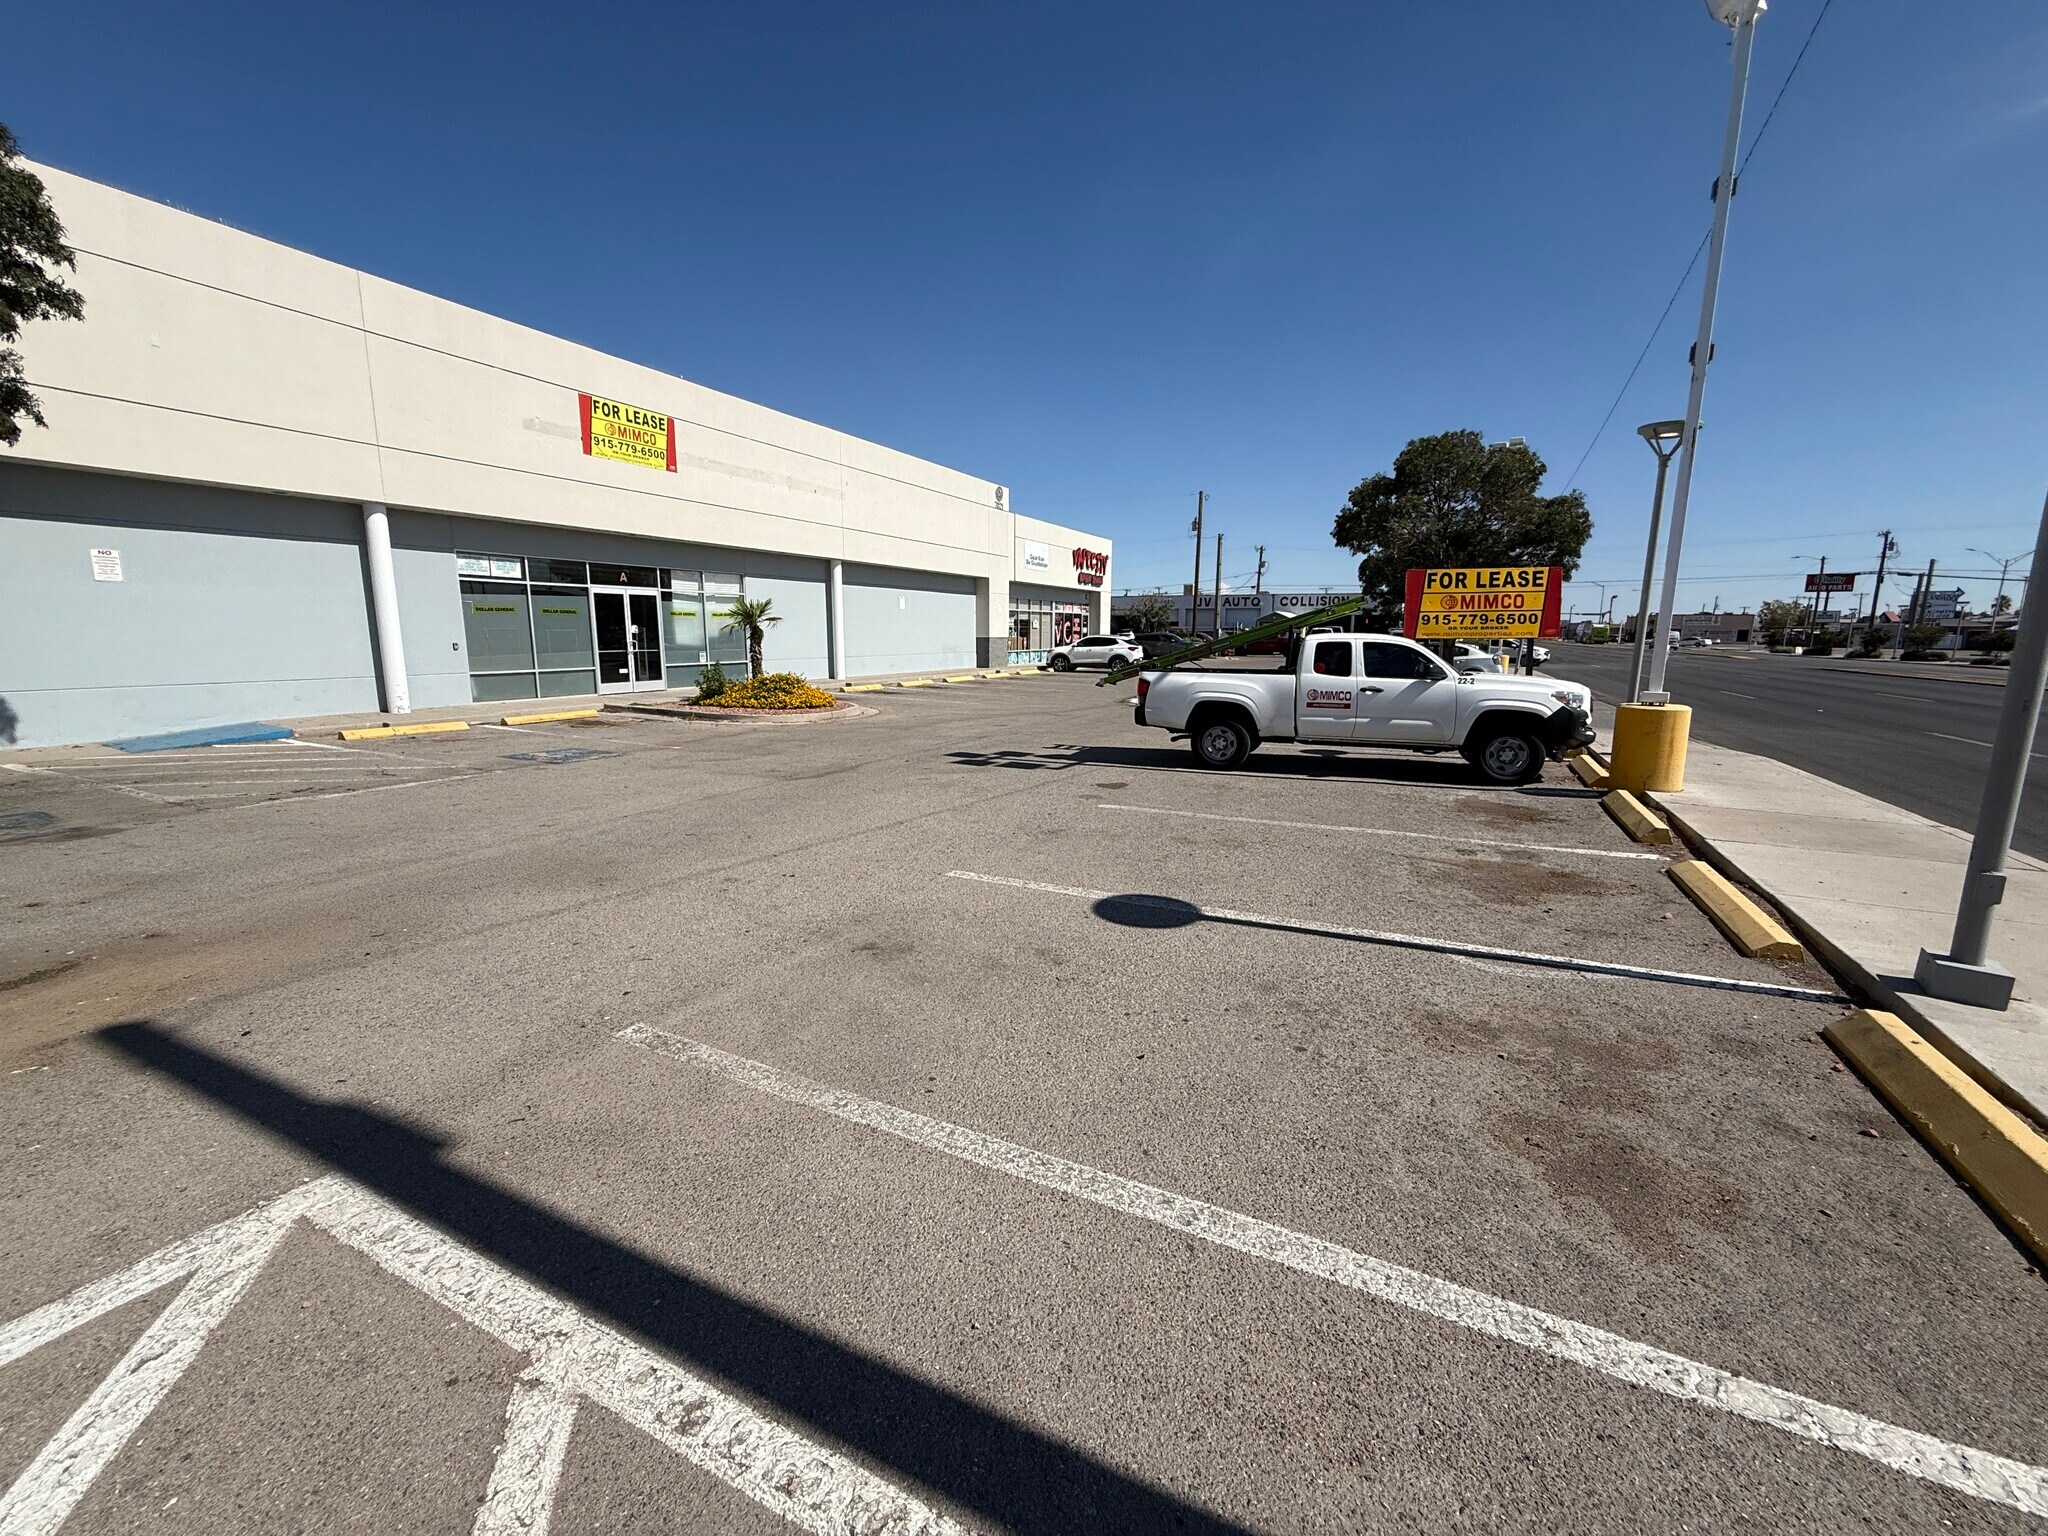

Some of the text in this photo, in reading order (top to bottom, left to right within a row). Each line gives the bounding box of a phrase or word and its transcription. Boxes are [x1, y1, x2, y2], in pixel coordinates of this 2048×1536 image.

[592, 399, 666, 431] FOR LEASE
[617, 425, 657, 446] MIMCO
[593, 436, 665, 460] 915-779-6500
[620, 572, 628, 582] A
[1426, 570, 1544, 589] FOR LEASE
[1197, 595, 1349, 607] JV AUTO COLLISION
[1460, 593, 1525, 610] MIMCO
[1421, 612, 1539, 626] 915-779-6500
[1457, 677, 1475, 685] 22-2
[1320, 690, 1352, 701] MIMCO
